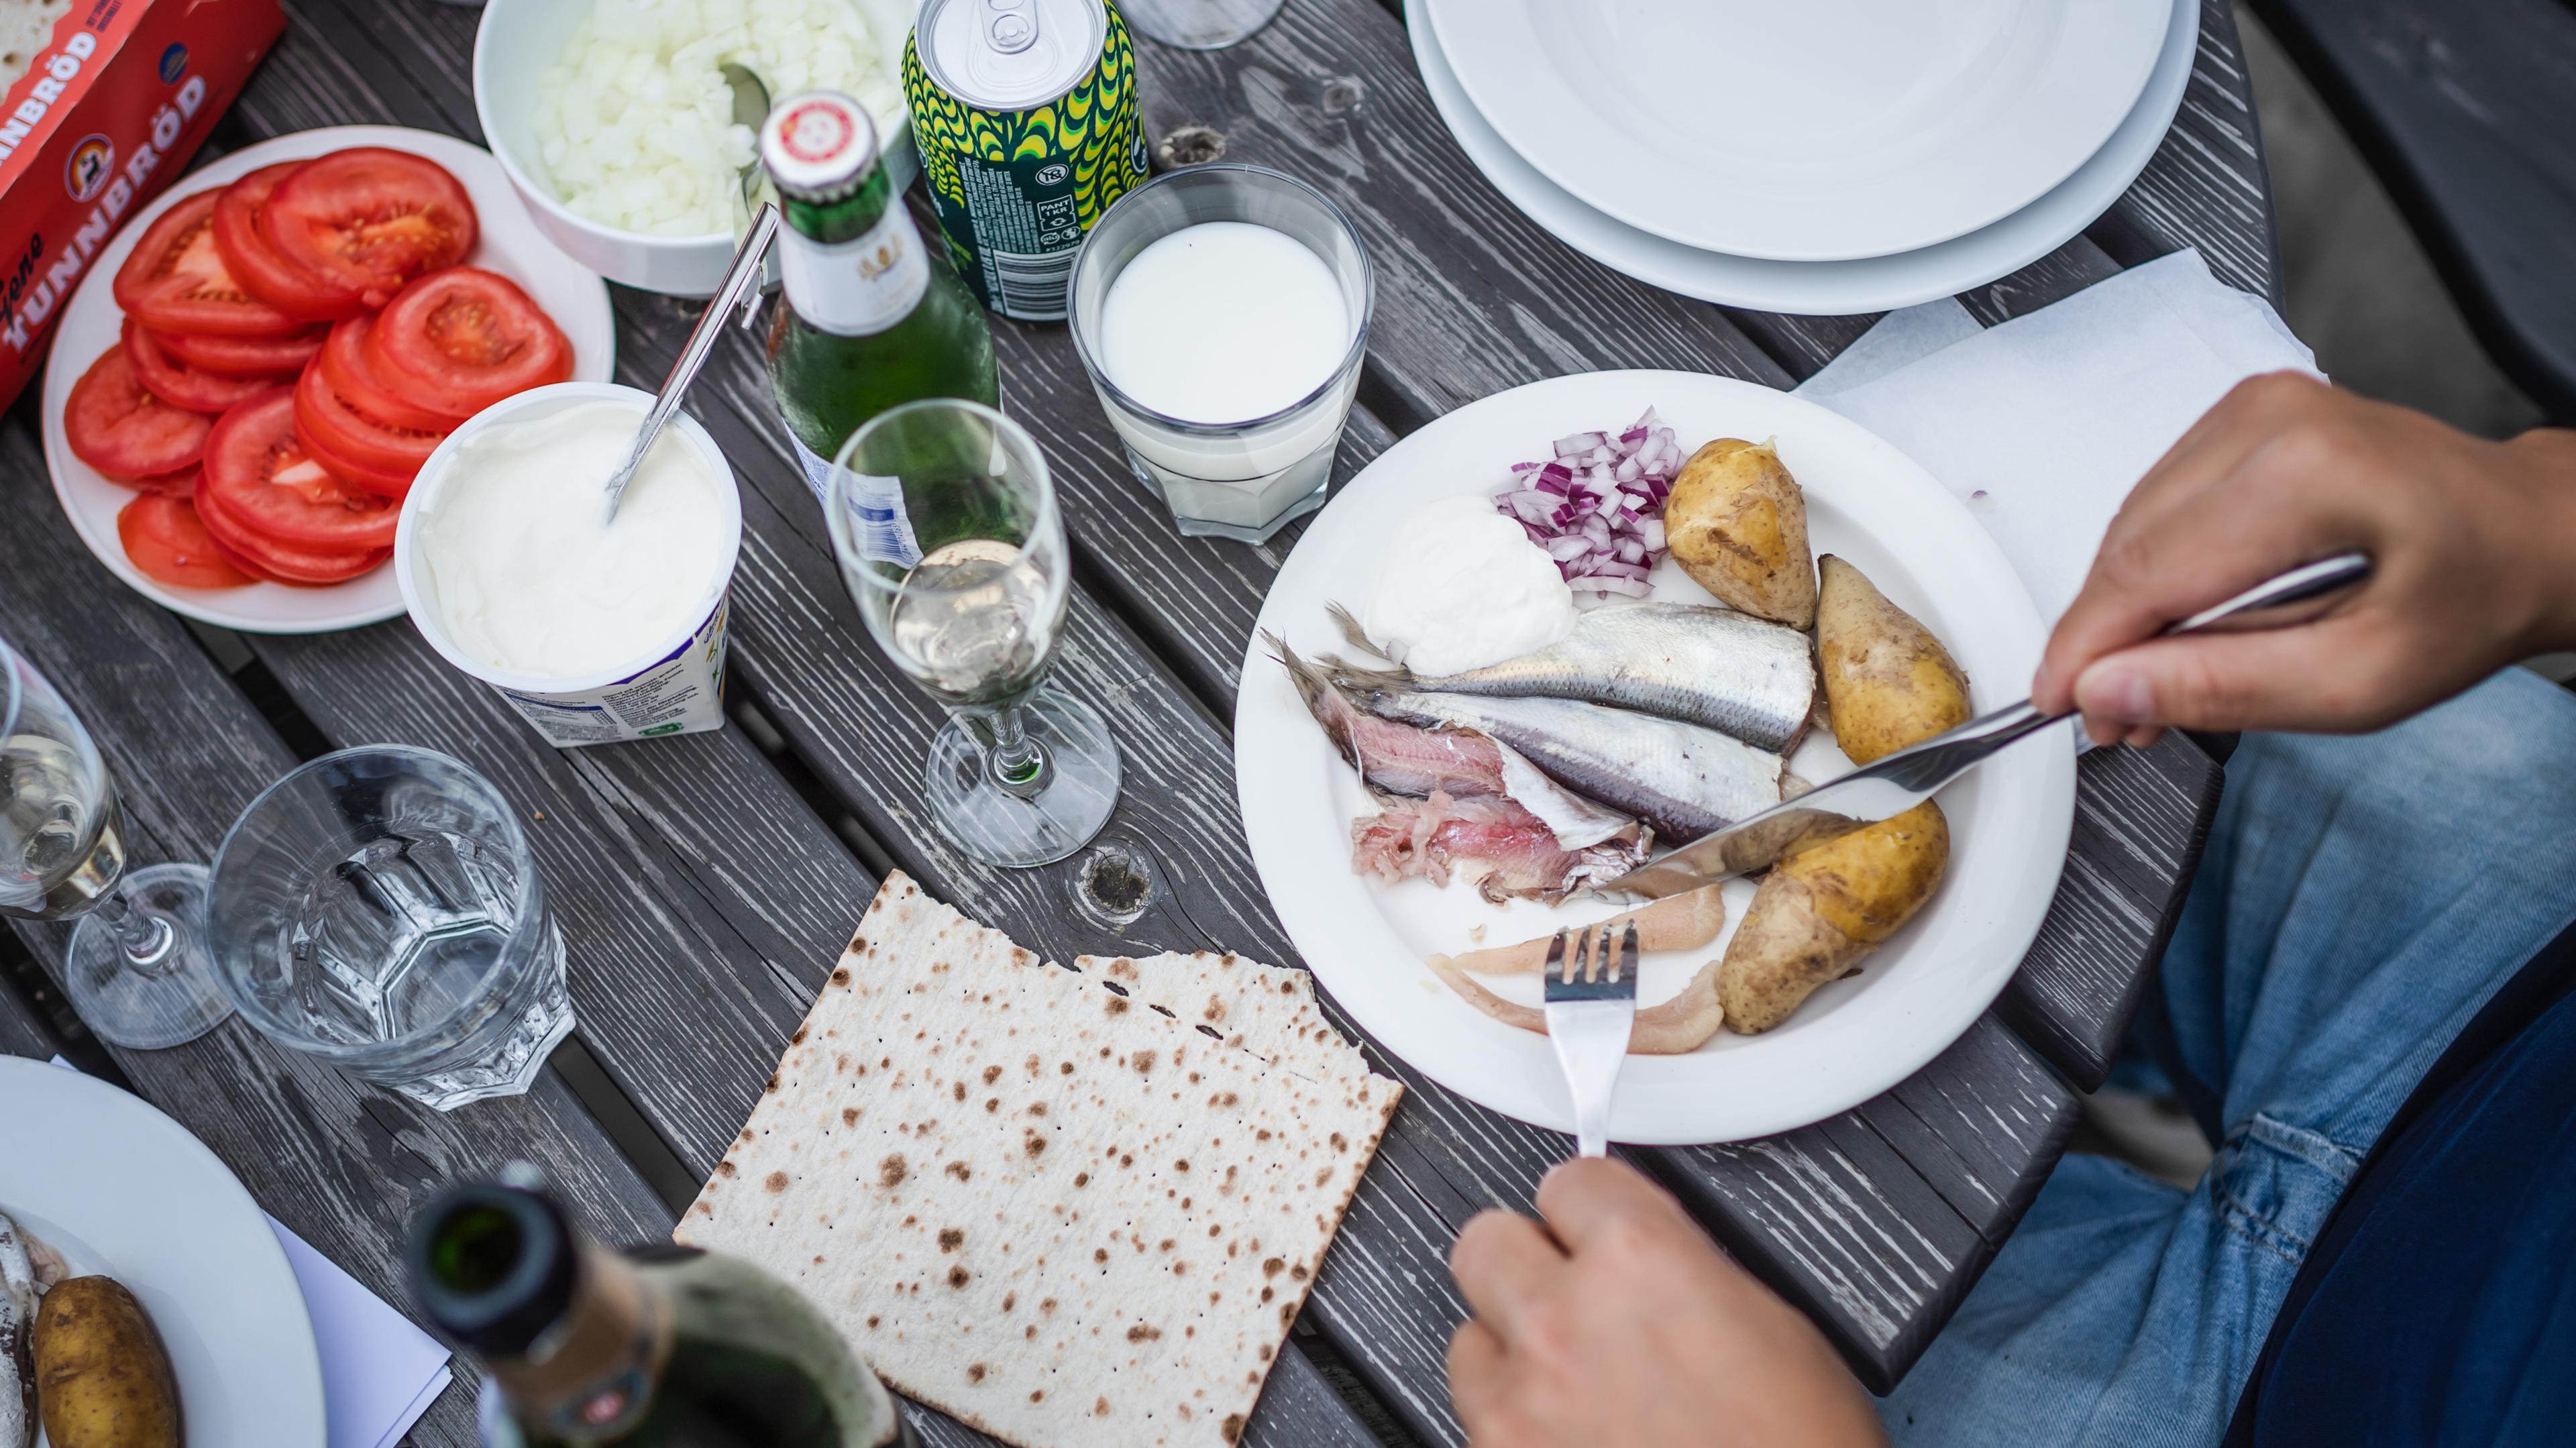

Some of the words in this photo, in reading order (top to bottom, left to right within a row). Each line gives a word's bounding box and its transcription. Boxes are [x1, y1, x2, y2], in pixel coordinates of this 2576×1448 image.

[1040, 199, 1070, 211] PANT
[1053, 207, 1068, 215] KR
[4, 75, 205, 353] TUNNBRÖD
